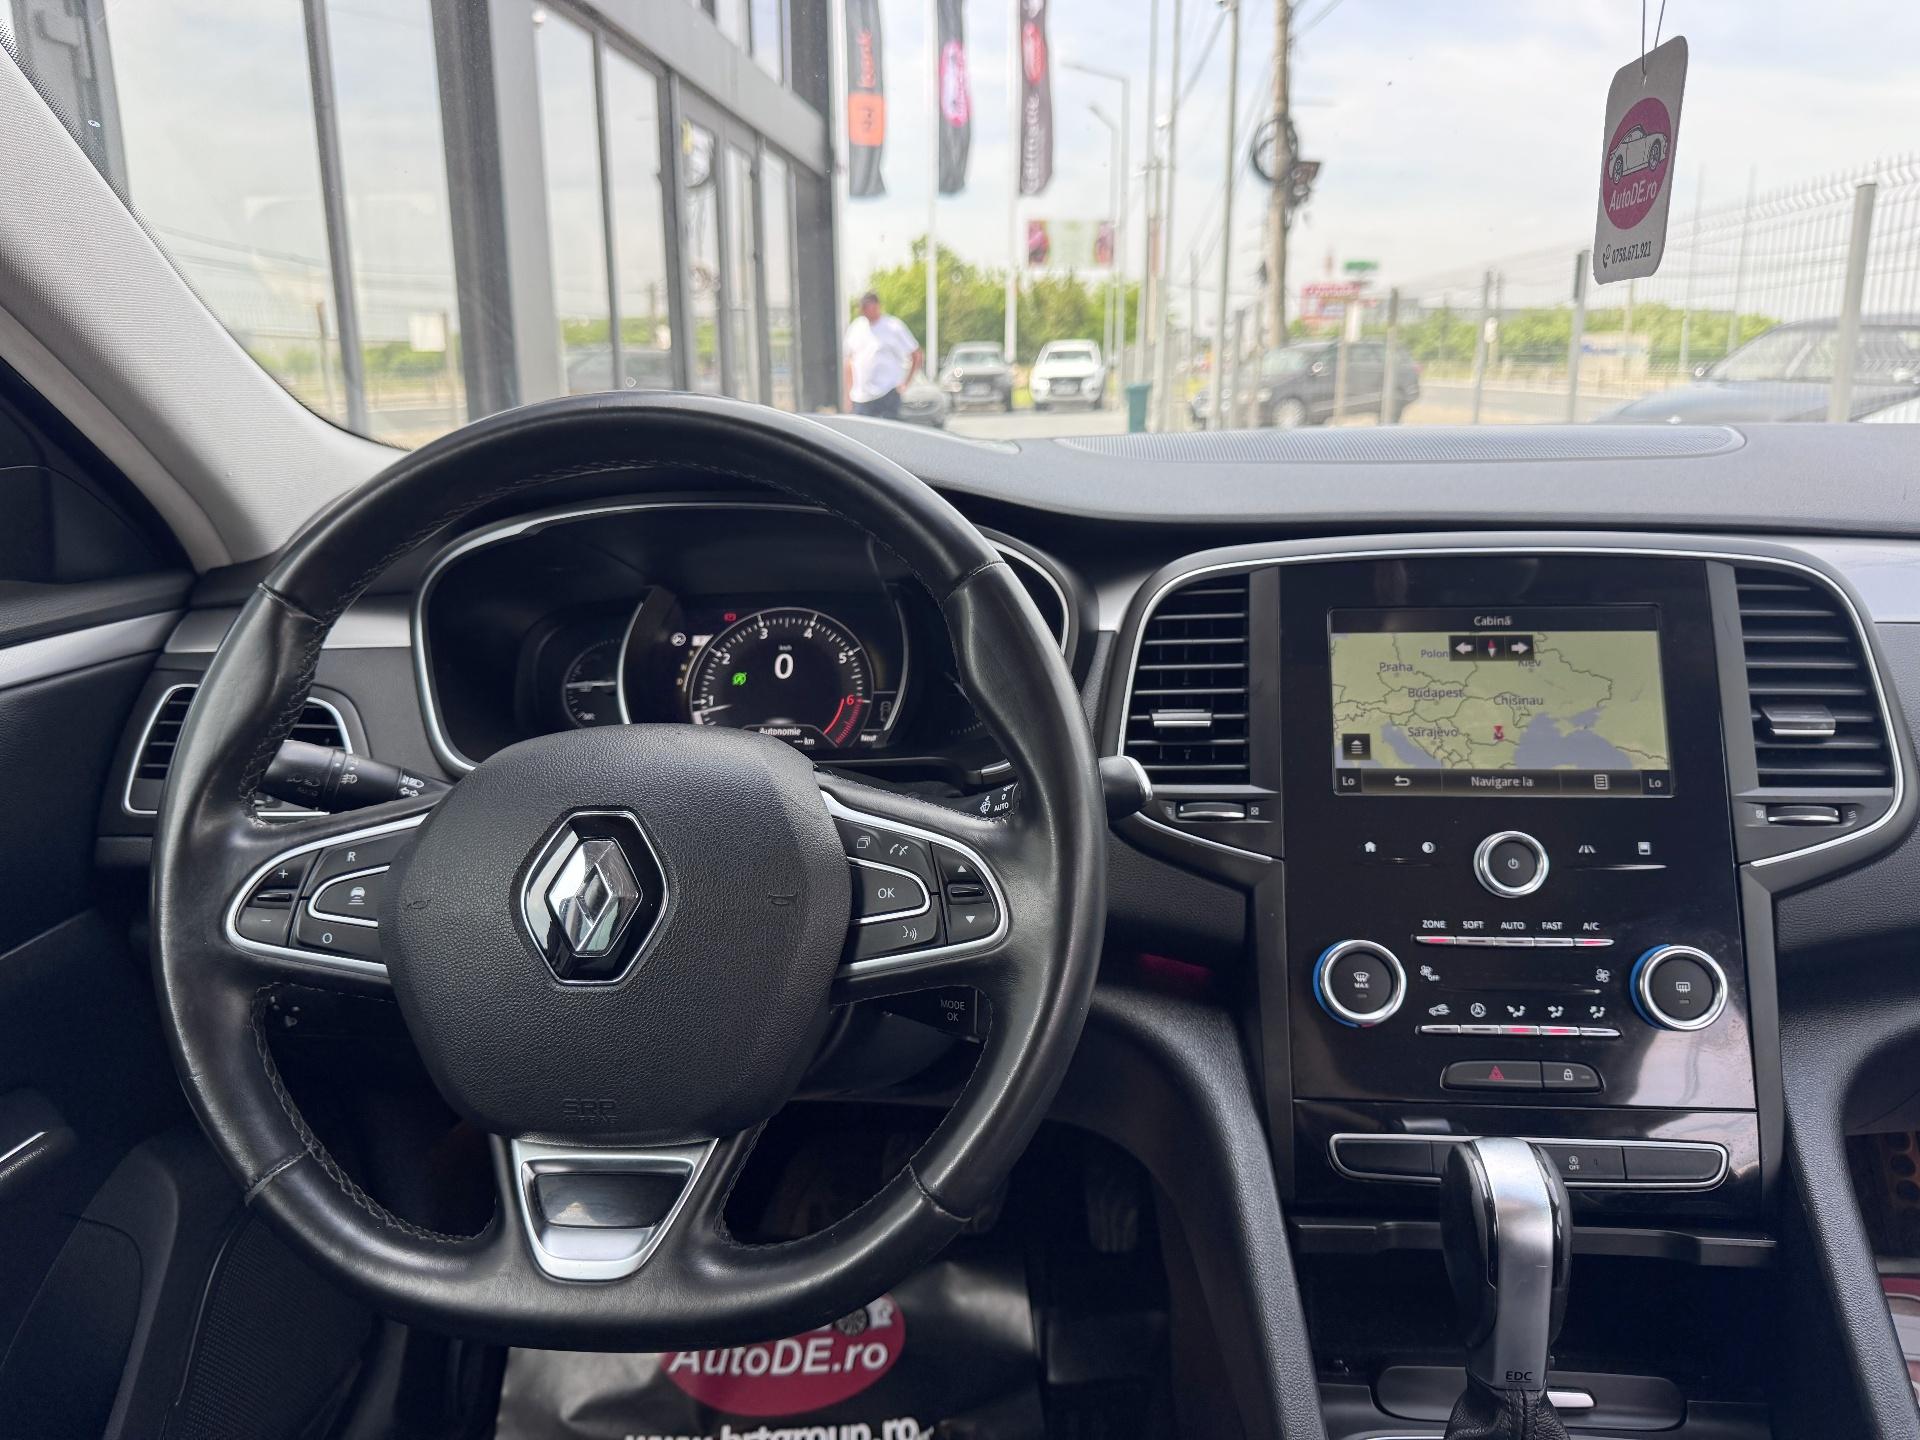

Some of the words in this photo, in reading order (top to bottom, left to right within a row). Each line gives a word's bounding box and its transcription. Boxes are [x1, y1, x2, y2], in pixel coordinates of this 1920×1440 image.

[1608, 181, 1657, 212] AutoDE.ro
[1611, 241, 1651, 263] 0758.671.921
[759, 628, 768, 640] 3
[803, 628, 813, 639] 4
[721, 653, 731, 665] 2
[838, 653, 847, 664] 5
[774, 653, 794, 680] 0
[1379, 662, 1414, 672] Praha
[1408, 688, 1464, 700] Budapest
[708, 695, 714, 706] 1
[846, 695, 855, 705] 6
[760, 727, 801, 736] Autonomie
[1407, 727, 1459, 740] Sarajevo
[1342, 776, 1356, 786] Lo
[1471, 776, 1521, 790] Navigare
[1522, 776, 1534, 787] la
[1649, 778, 1662, 788] Lo
[994, 801, 1009, 812] AUTO
[347, 851, 357, 862] R
[877, 887, 896, 899] OK
[1422, 919, 1447, 929] ZONE
[1462, 920, 1484, 930] SOFT
[1500, 921, 1526, 931] AUTO
[1541, 921, 1563, 931] FAST
[1582, 922, 1600, 932] A/C
[940, 999, 966, 1011] MODE
[946, 1011, 960, 1022] OK
[668, 1336, 889, 1376] AutoDE.ro
[1505, 1370, 1533, 1381] EDC
